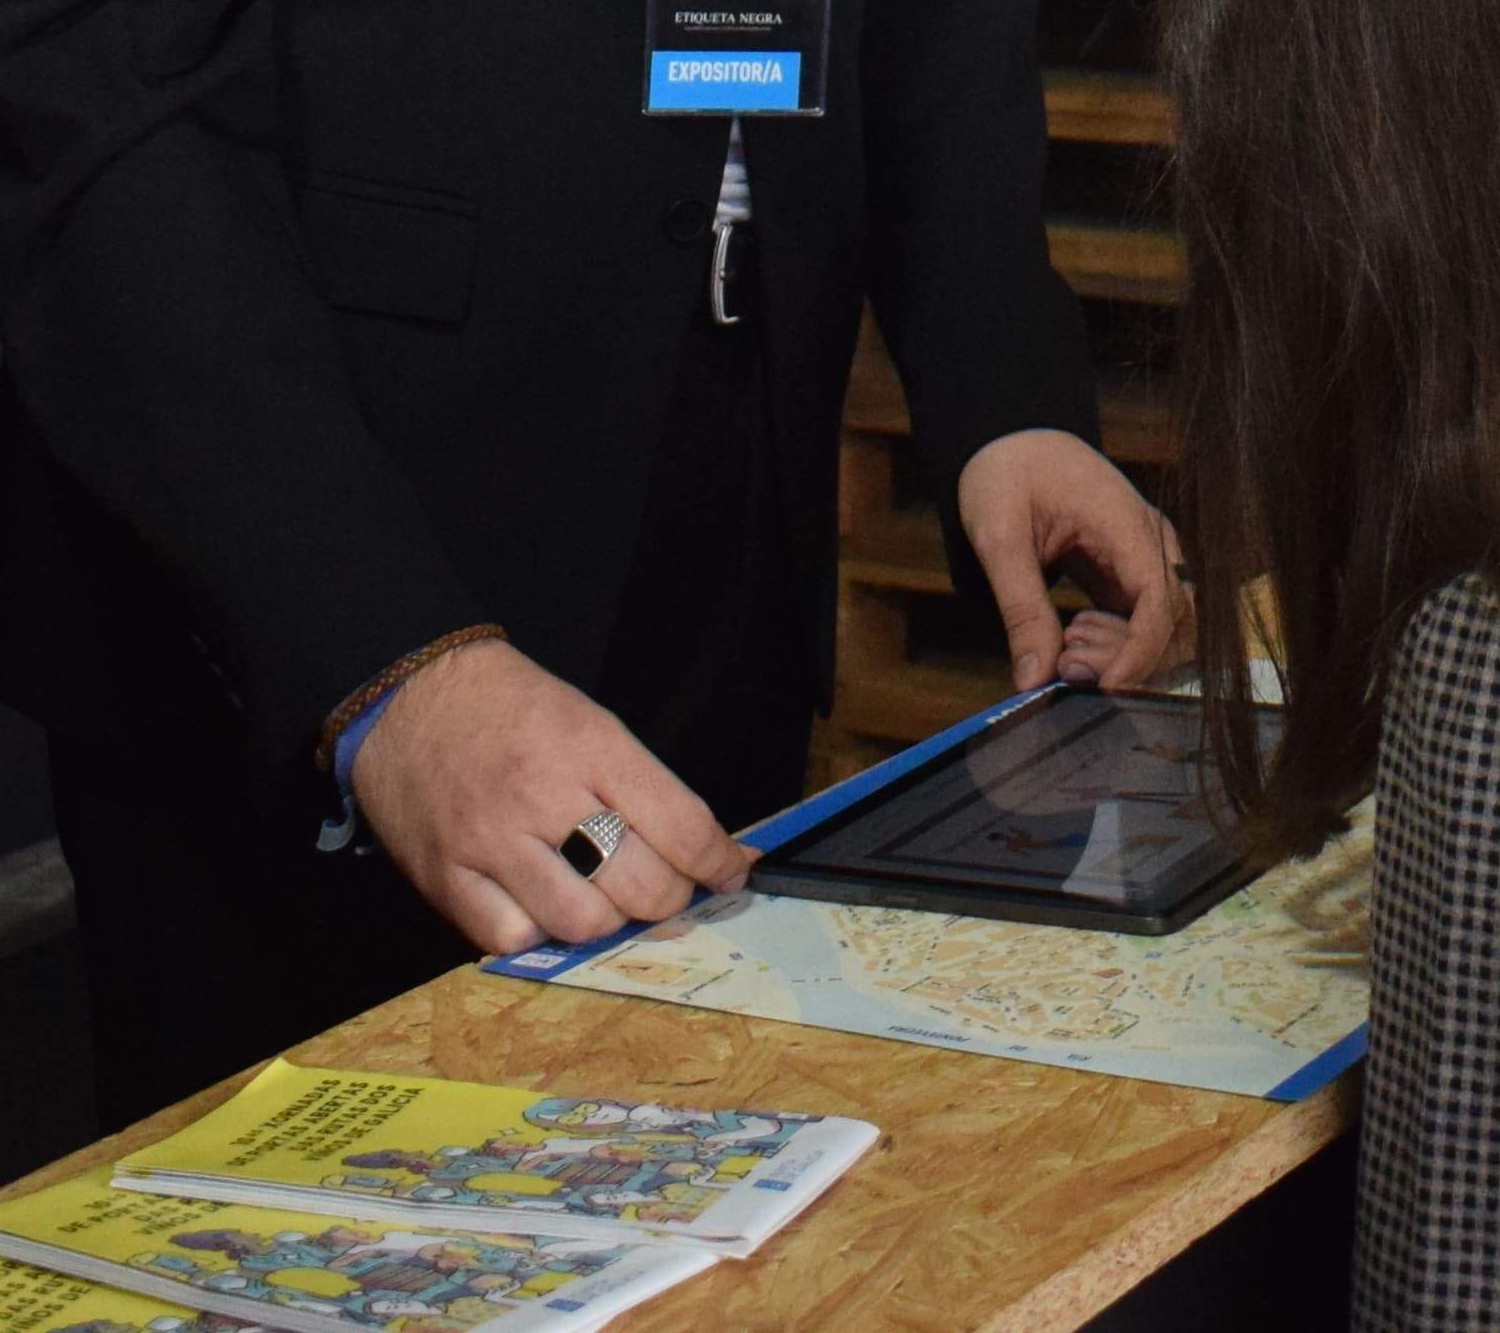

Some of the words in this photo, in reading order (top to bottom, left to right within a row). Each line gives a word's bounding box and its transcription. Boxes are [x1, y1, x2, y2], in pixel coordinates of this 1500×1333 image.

[675, 10, 736, 25] ETIQUETA
[739, 11, 783, 25] NEGRA
[668, 59, 783, 85] EXPOSITOR/A
